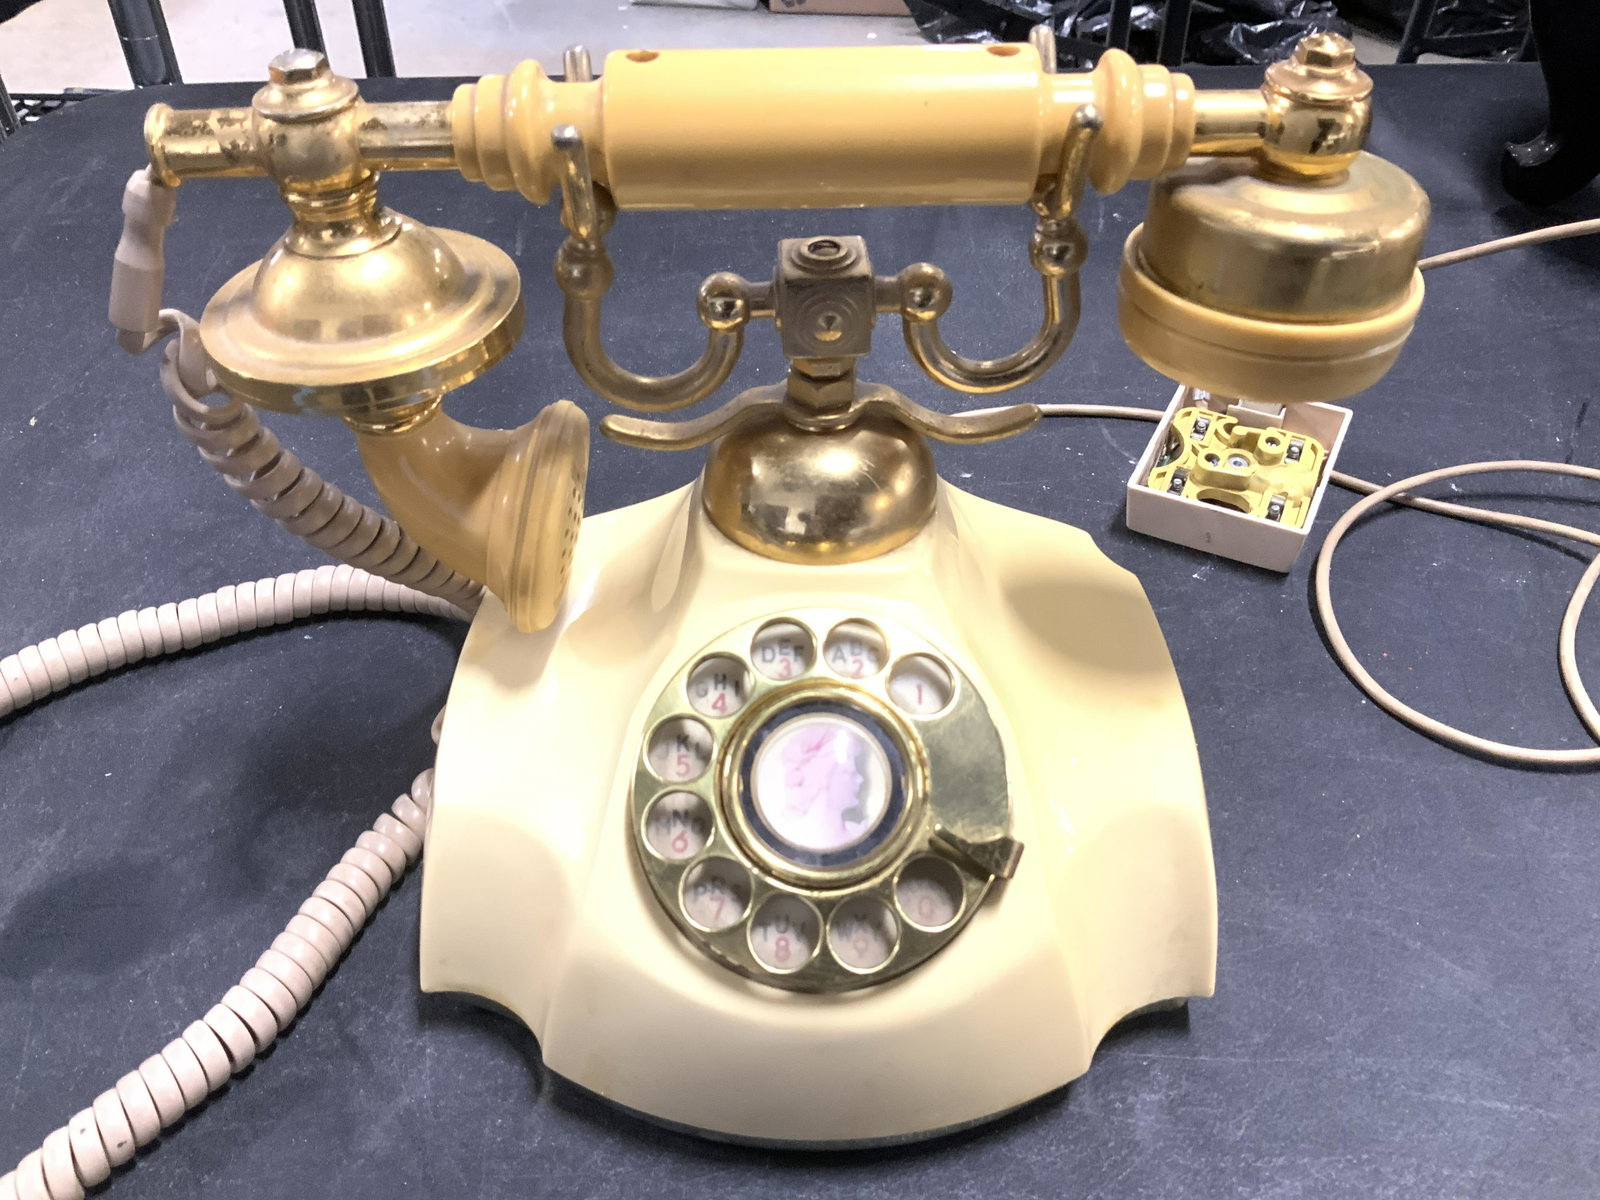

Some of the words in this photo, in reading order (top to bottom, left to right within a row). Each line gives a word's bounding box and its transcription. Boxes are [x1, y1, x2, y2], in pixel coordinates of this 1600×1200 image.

[760, 638, 804, 665] DEF
[778, 657, 793, 679] 3
[851, 658, 865, 678] 2
[695, 673, 741, 698] GHI
[916, 683, 923, 705] 1
[711, 692, 728, 713] 4
[676, 754, 690, 777] 5
[672, 830, 689, 853] 6
[709, 895, 725, 921] 7
[774, 936, 791, 963] 8
